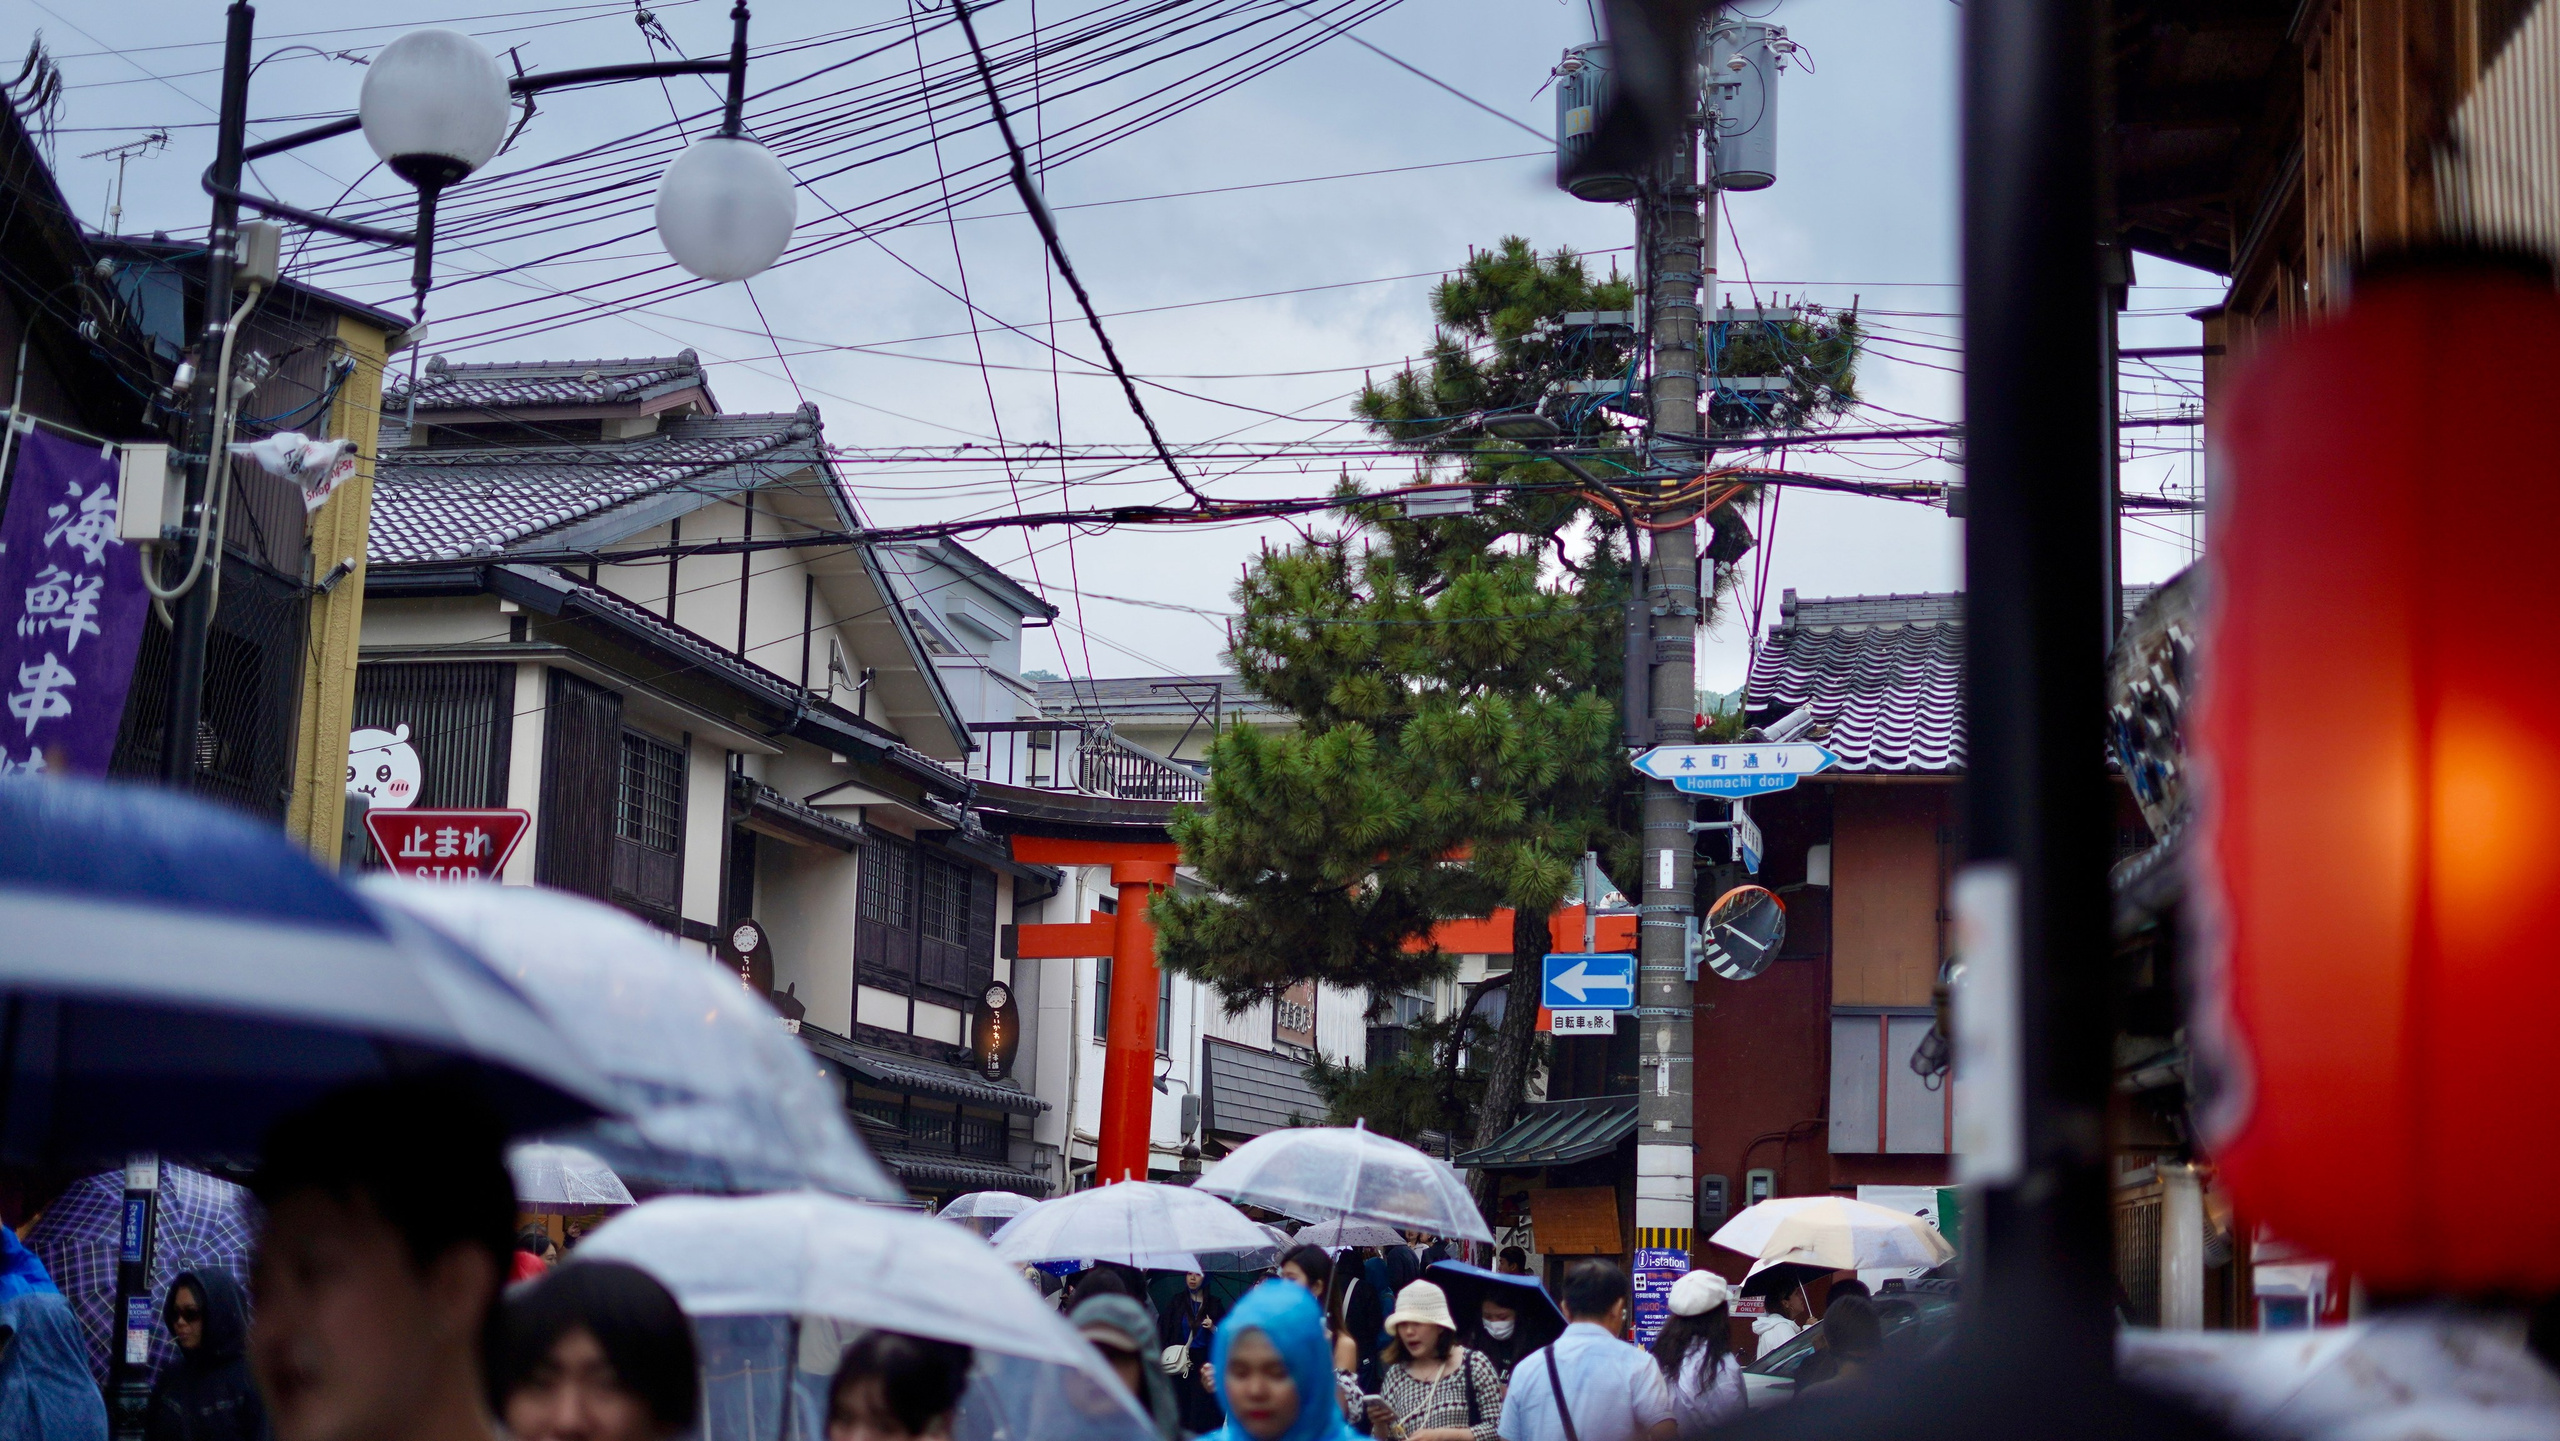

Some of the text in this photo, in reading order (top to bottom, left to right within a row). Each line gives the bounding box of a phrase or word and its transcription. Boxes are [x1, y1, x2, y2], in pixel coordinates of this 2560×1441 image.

[1680, 752, 1789, 771] 本町通り
[1687, 774, 1784, 789] Honmachi dori
[399, 826, 493, 857] 止まれ
[415, 866, 480, 886] STOP
[1554, 1015, 1611, 1029] 自転車を除く
[1649, 1256, 1685, 1268] i-station
